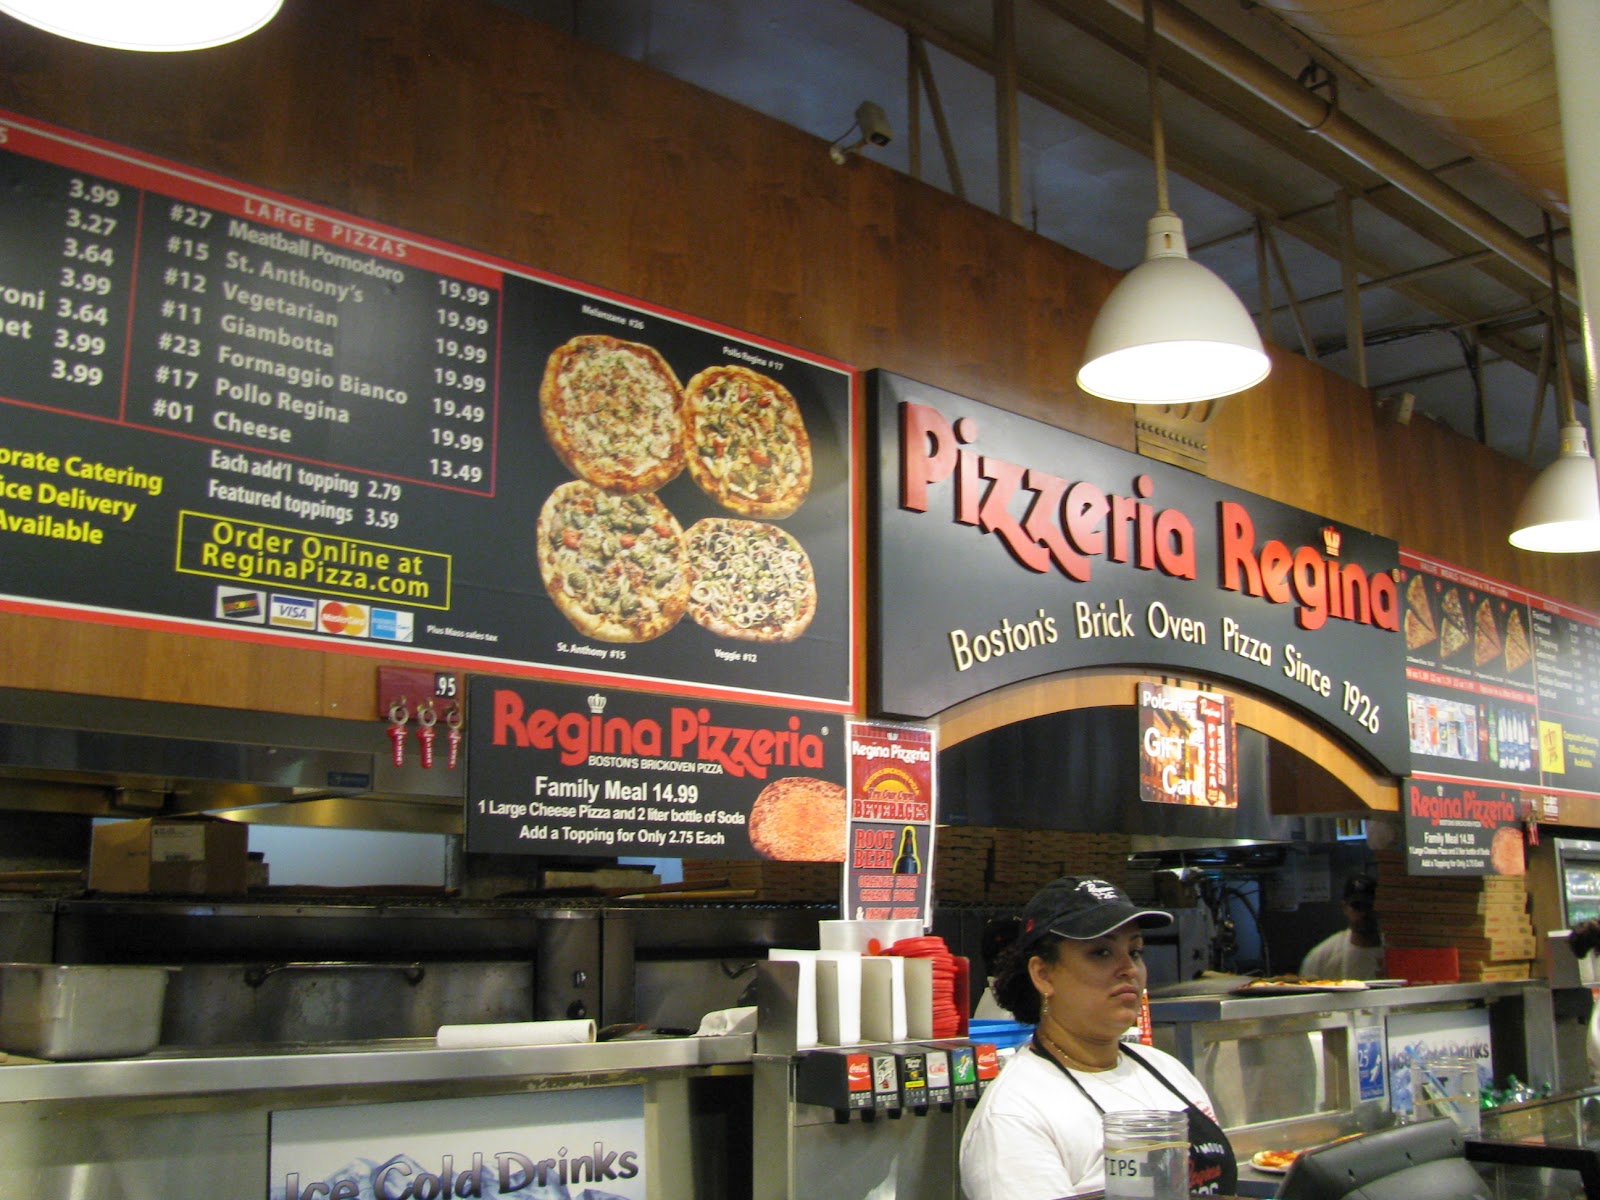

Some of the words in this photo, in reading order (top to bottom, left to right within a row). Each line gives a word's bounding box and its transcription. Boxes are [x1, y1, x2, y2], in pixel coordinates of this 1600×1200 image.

[69, 178, 120, 207] 3.99
[66, 208, 118, 236] 3.27
[244, 199, 315, 232] LARGE
[331, 224, 408, 258] PIZZAS
[63, 238, 114, 267] 3.64
[170, 204, 213, 229] #27
[228, 220, 309, 258] Meatball
[312, 244, 405, 283] Pomodoro
[439, 279, 490, 306] 19.99
[60, 268, 111, 295] 3.99
[167, 236, 209, 261] #15
[226, 251, 254, 274] St.
[260, 261, 364, 303] Anthony's
[437, 309, 489, 335] 19.99
[57, 298, 108, 326] 3.64
[164, 267, 207, 294] #12
[223, 281, 339, 328] Vegetarian
[435, 338, 488, 364] 19.99
[54, 329, 106, 355] 3.99
[161, 299, 202, 325] #11
[221, 314, 335, 357] Giambotta
[434, 367, 486, 393] 19.99
[51, 359, 103, 386] 3.99
[158, 332, 201, 357] #23
[218, 346, 334, 388] Formaggio
[339, 374, 408, 405] Bianco
[432, 398, 485, 423] 19.49
[155, 365, 199, 390] #17
[215, 378, 272, 406] Pollo
[277, 392, 350, 423] Regina
[431, 428, 484, 453] 19.99
[153, 400, 194, 424] #01
[213, 411, 292, 443] Cheese
[429, 458, 483, 483] 13.49
[64, 456, 163, 496] Catering
[210, 449, 249, 475] Each
[298, 468, 360, 499] topping
[368, 480, 402, 502] 2.79
[38, 483, 137, 522] Delivery
[208, 478, 282, 510] Featured
[285, 494, 353, 525] toppings
[365, 508, 400, 530] 3.59
[901, 401, 1196, 582] Pizzeria
[1219, 502, 1400, 630] Regina
[212, 521, 294, 555] Order
[301, 536, 390, 571] Online
[398, 556, 424, 576] at
[202, 543, 430, 599] ReginaPizza.com
[279, 605, 308, 619] VISA
[570, 643, 608, 660] Anthony
[609, 649, 627, 660] #15
[714, 648, 741, 662] Veggie
[743, 652, 758, 663] #12
[951, 608, 1058, 672] Boston's
[1074, 600, 1135, 641] Brick
[1148, 602, 1206, 645] Oven
[1222, 618, 1272, 667] Pizza
[1284, 644, 1331, 697] Since
[1343, 682, 1380, 734] 1926
[435, 676, 456, 697] .95
[492, 689, 663, 767] Regina
[671, 707, 825, 780] Pizzeria
[852, 741, 890, 760] Regina
[890, 744, 930, 764] Pizzeria
[697, 762, 723, 775] PIZZA
[535, 775, 600, 804] Family
[604, 780, 648, 802] Meal
[652, 783, 699, 804] 14.99
[478, 800, 486, 815] 1
[488, 800, 527, 819] Large
[528, 801, 577, 819] Cheese
[578, 804, 611, 820] Pizza
[612, 807, 636, 821] and
[637, 807, 646, 821] 2
[647, 807, 669, 823] liter
[671, 808, 703, 824] bottle
[704, 810, 718, 824] of
[717, 811, 746, 825] Soda
[853, 799, 929, 821] BEVERAGES
[1410, 786, 1462, 826] Regina
[1463, 790, 1515, 828] Pizzeria
[519, 824, 547, 840] Add
[550, 828, 559, 841] a
[562, 826, 614, 845] Topping
[617, 828, 635, 842] for
[637, 829, 667, 846] Only
[668, 830, 694, 845] 2.75
[696, 831, 725, 846] Each
[855, 829, 896, 849] ROOT
[1424, 832, 1444, 846] Family
[853, 849, 894, 869] BEER
[374, 1152, 483, 1200] Cold
[494, 1141, 640, 1194] Drinks
[1104, 1157, 1138, 1177] IPS
